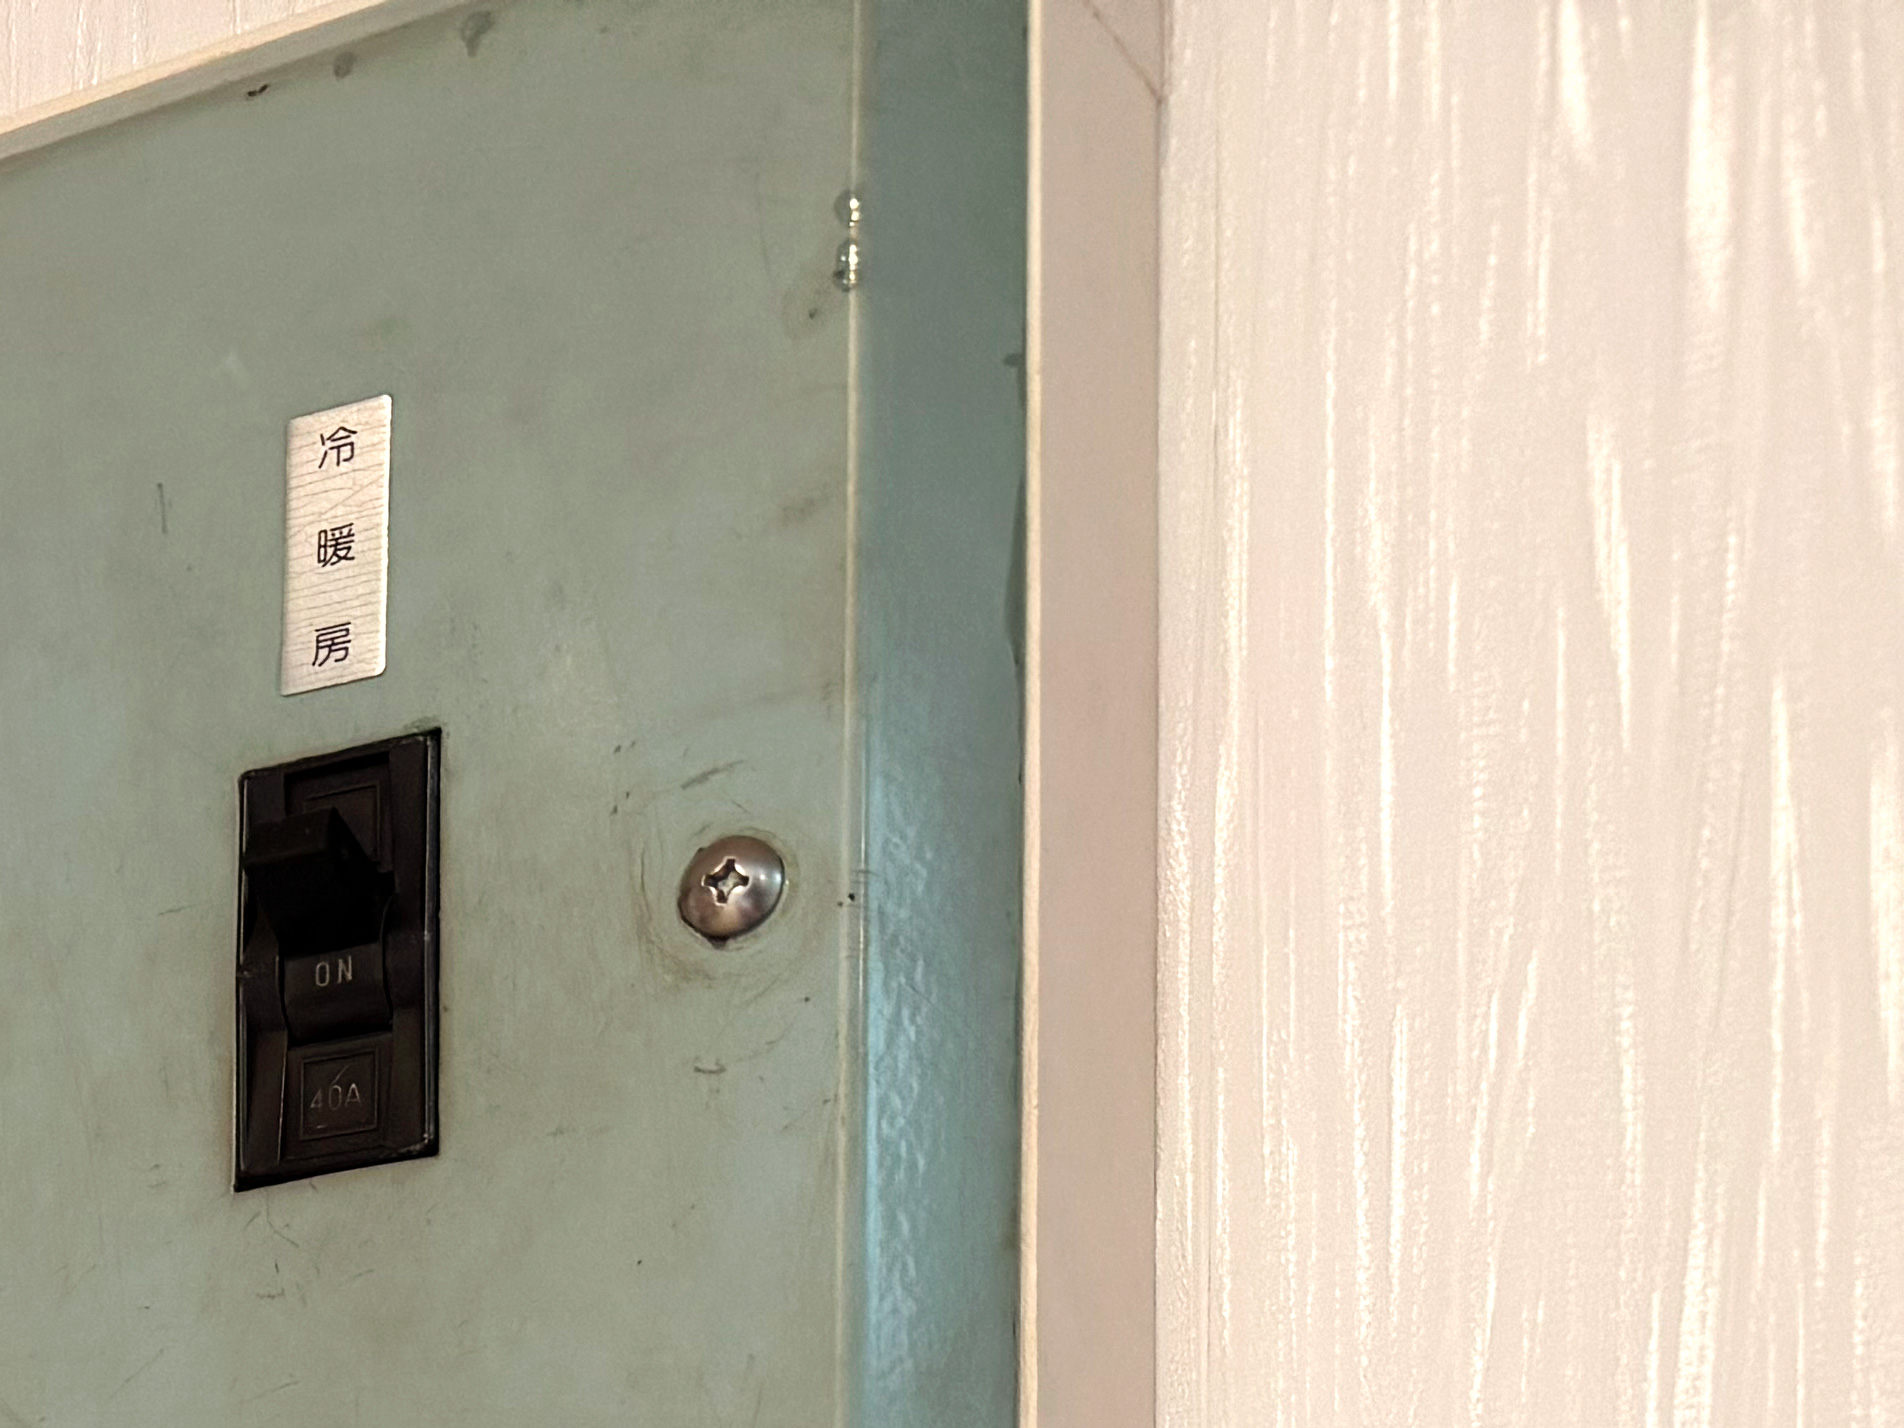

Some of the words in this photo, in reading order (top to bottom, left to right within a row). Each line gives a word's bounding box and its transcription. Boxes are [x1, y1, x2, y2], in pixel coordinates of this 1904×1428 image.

[312, 426, 357, 669] 冷暖房
[314, 957, 353, 988] ON
[309, 1080, 361, 1113] 40A
